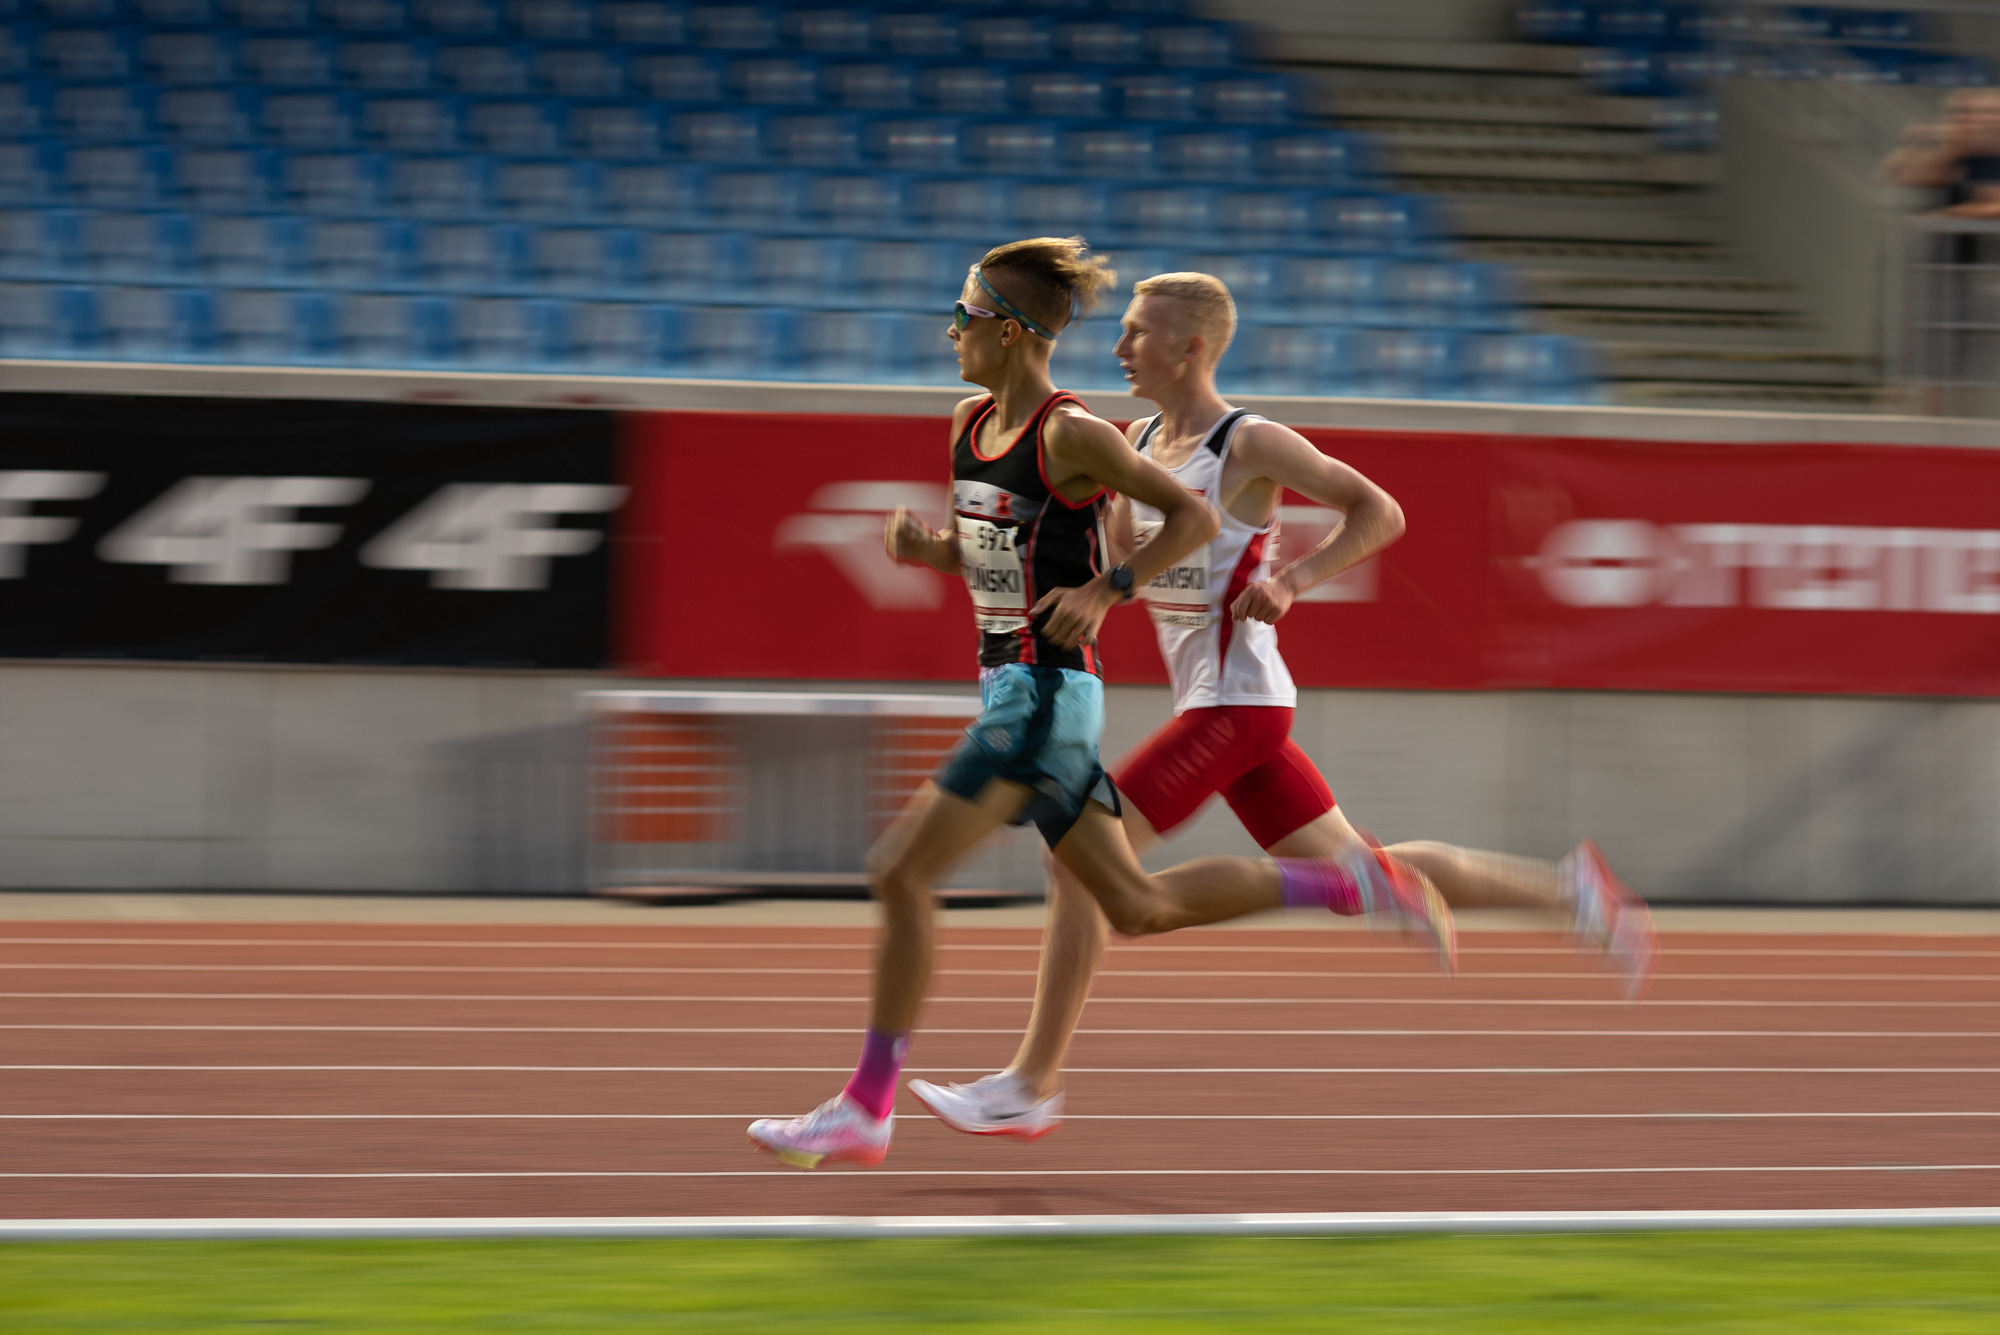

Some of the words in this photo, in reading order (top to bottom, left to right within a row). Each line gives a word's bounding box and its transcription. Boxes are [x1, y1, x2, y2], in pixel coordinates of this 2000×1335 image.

[95, 475, 373, 585] 4F
[357, 481, 632, 590] 4F
[977, 526, 1013, 551] 592
